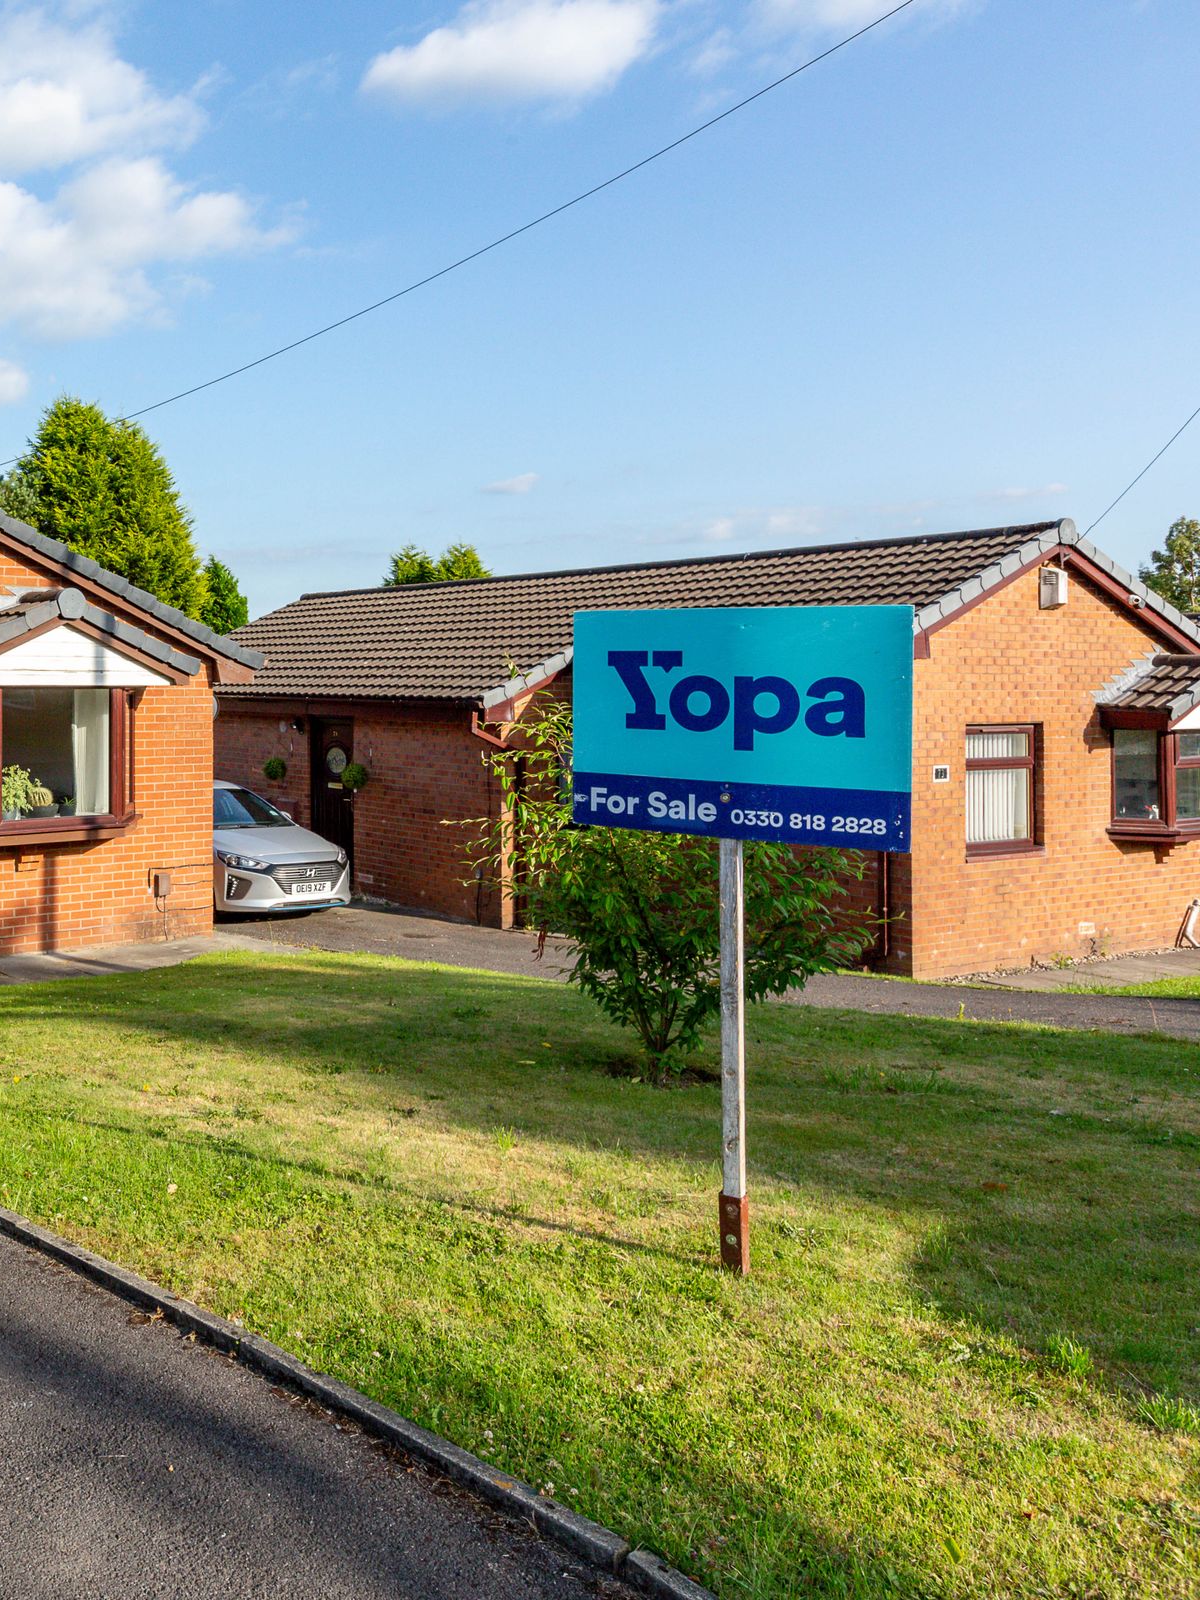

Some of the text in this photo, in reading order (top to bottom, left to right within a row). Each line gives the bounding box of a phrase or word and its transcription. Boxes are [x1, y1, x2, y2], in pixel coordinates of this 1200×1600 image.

[607, 650, 866, 751] Yopa
[590, 786, 717, 823] For Sale
[730, 809, 887, 835] 0330 818 2828
